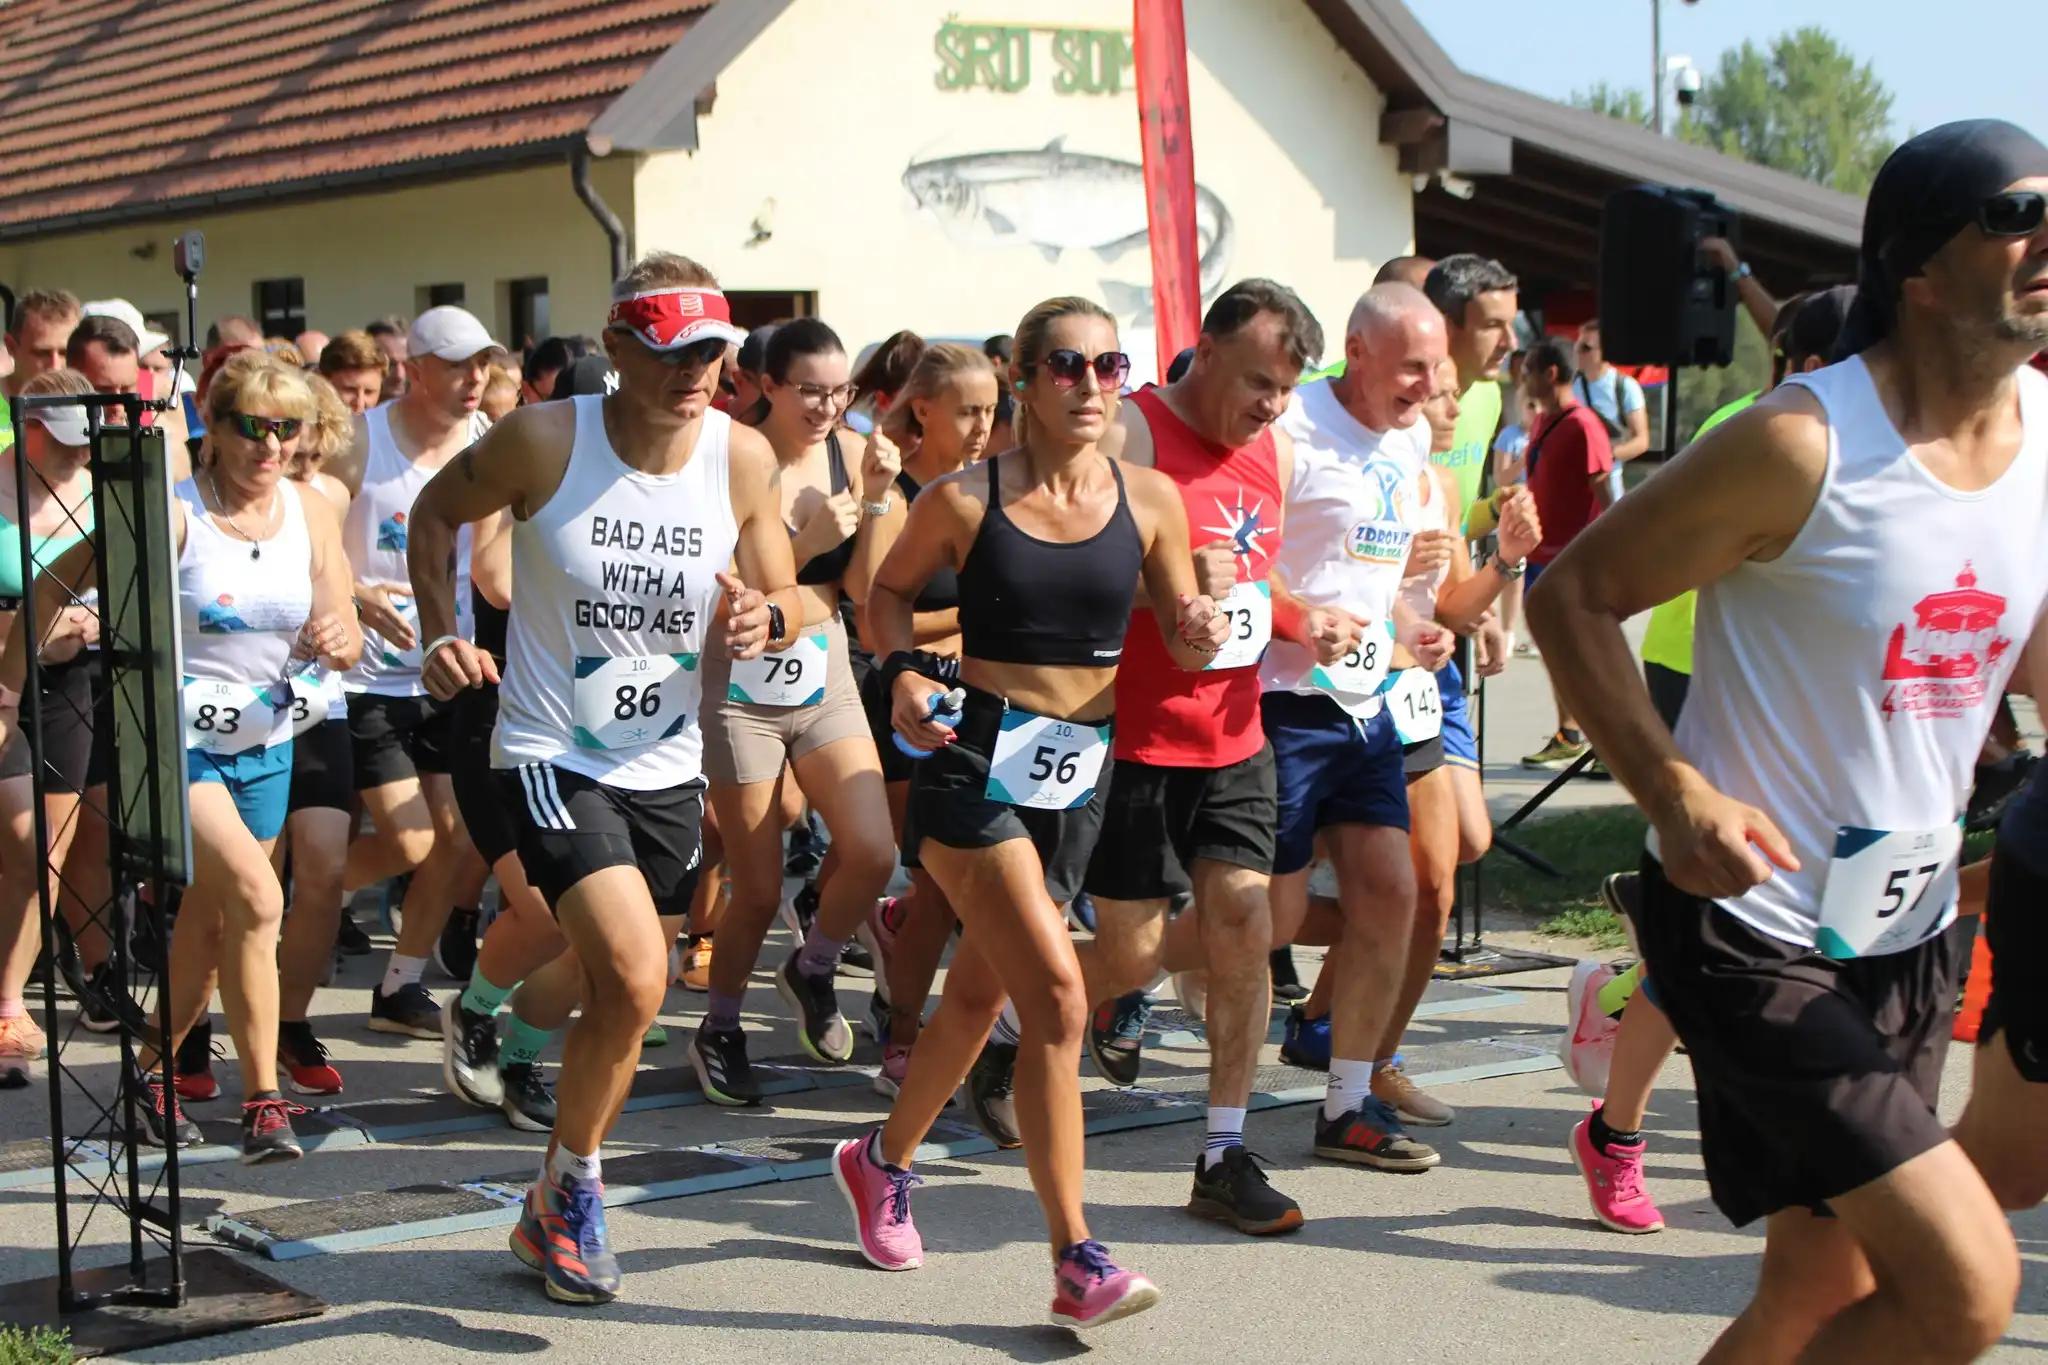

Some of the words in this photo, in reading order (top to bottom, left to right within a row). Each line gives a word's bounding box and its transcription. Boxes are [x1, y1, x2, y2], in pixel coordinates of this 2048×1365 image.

[591, 516, 645, 551] BAD
[651, 525, 703, 557] ASS
[602, 561, 664, 596] WITH
[668, 571, 685, 599] A
[575, 599, 645, 632] GOOD
[649, 609, 696, 634] ASS
[632, 660, 652, 671] 10.
[763, 656, 803, 685] 79
[614, 682, 661, 720] 86
[1403, 687, 1438, 719] 142
[193, 704, 241, 734] 83
[1055, 724, 1075, 738] 10.
[1028, 745, 1080, 784] 56
[1876, 862, 1940, 918] 57
